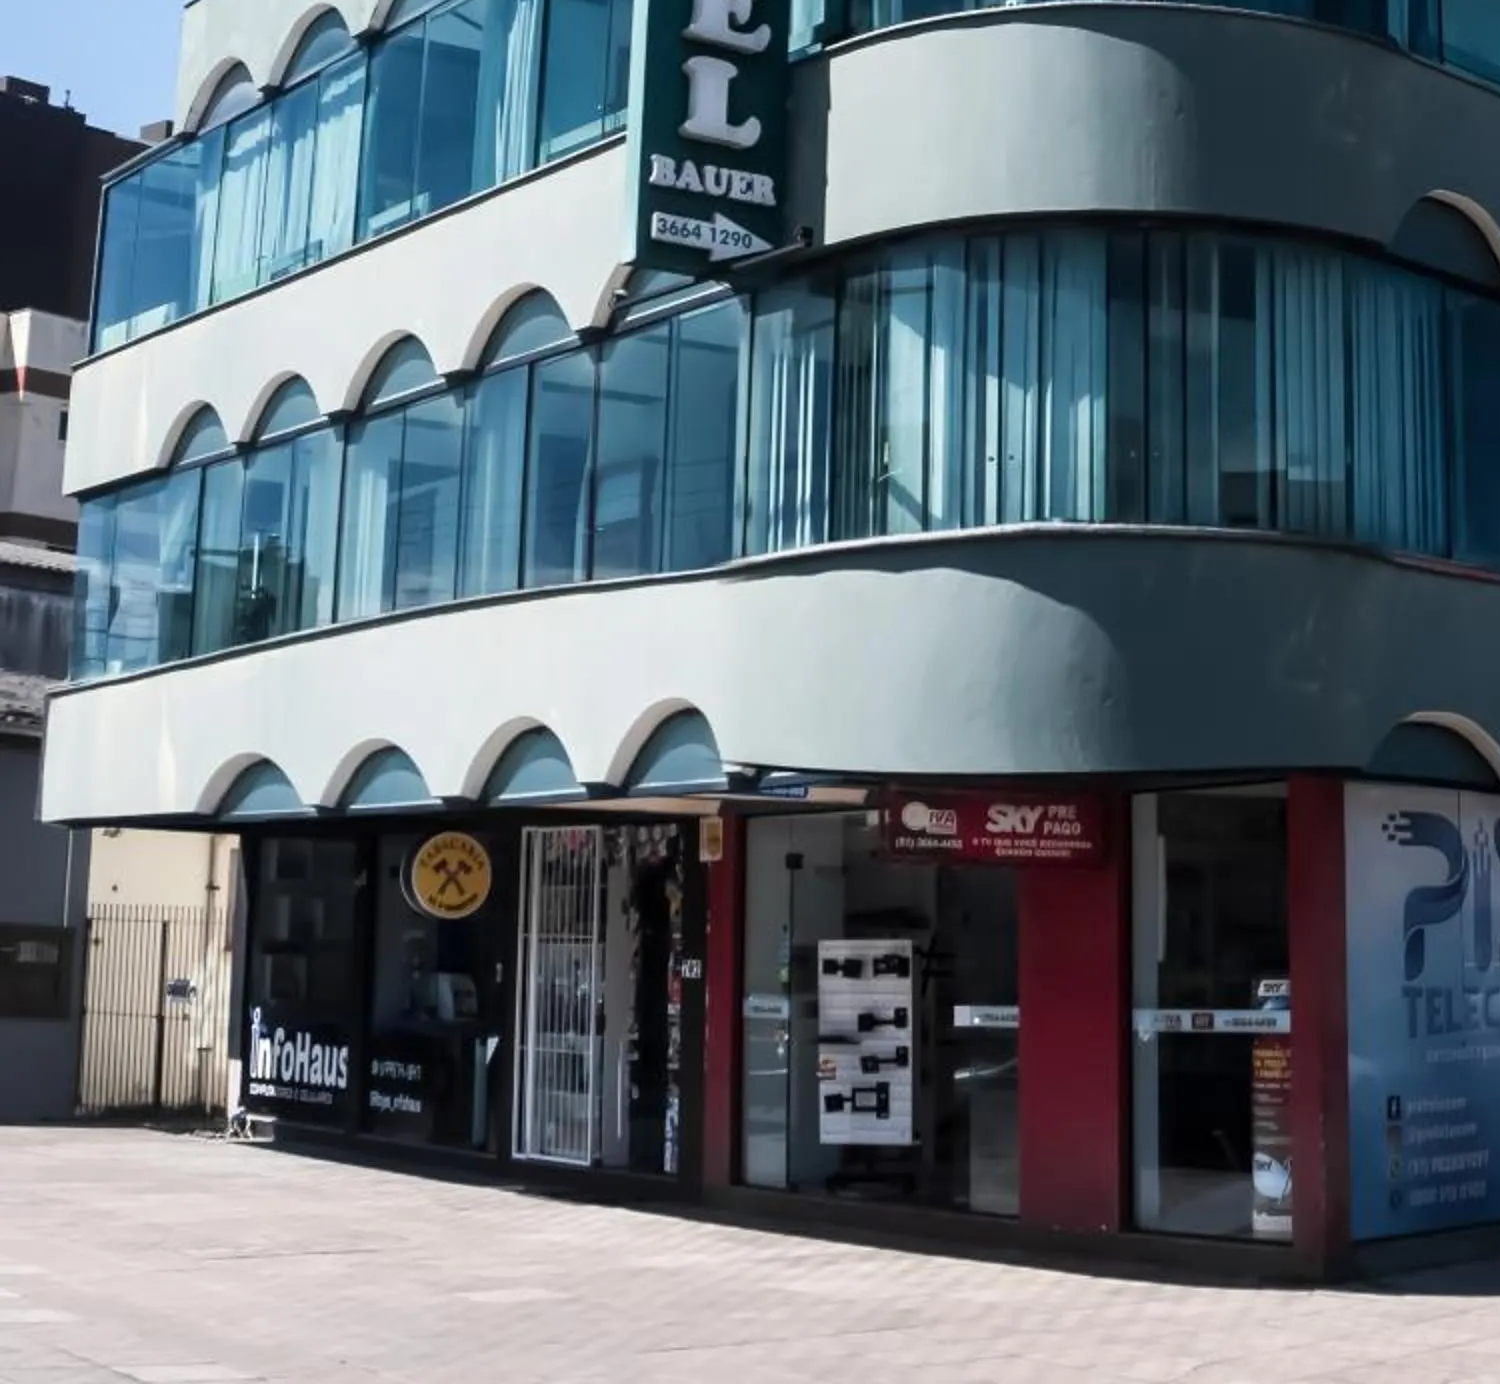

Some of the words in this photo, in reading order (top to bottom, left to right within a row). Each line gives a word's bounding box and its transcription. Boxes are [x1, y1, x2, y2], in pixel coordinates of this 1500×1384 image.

[649, 153, 777, 207] BAUER
[656, 217, 702, 241] 3664
[709, 227, 753, 249] 1290
[985, 804, 1045, 834] SKY
